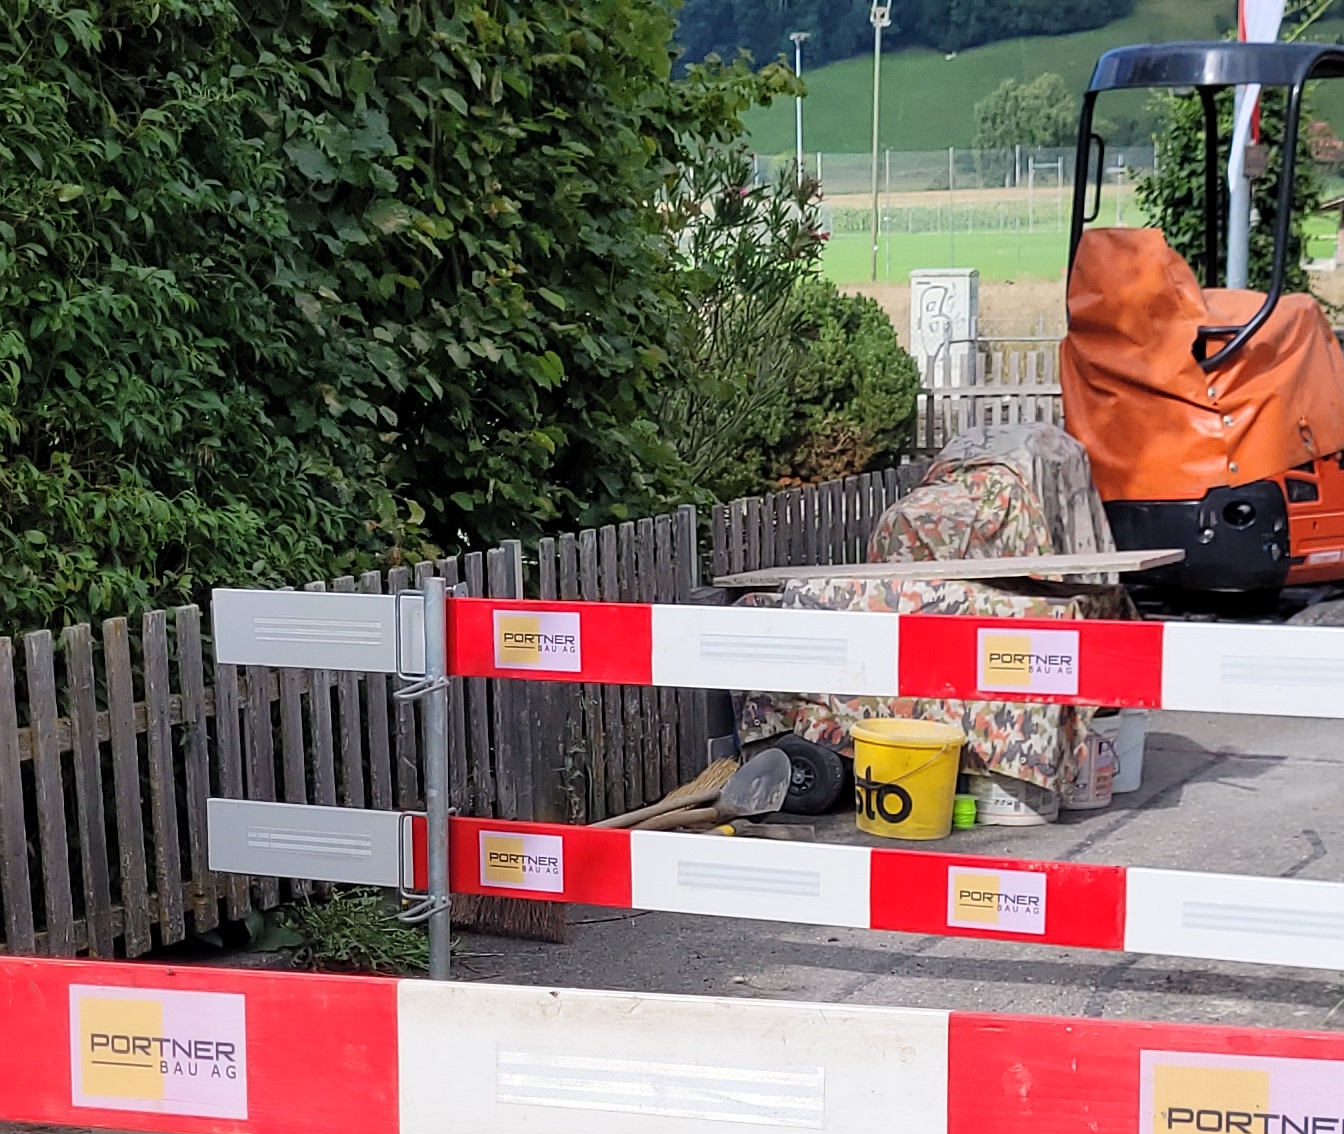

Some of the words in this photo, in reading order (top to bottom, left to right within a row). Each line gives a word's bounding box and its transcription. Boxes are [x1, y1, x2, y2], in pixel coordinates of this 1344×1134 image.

[503, 632, 575, 646] PORTNER
[562, 645, 576, 654] AG
[989, 652, 1073, 667] PORTNER
[1028, 665, 1051, 674] BAU
[1057, 666, 1073, 675] AG
[489, 851, 558, 867] PORTNER
[521, 865, 541, 874] BAU
[545, 867, 559, 875] AG
[959, 889, 1040, 907] PORTNER
[997, 904, 1019, 913] BAU
[1024, 906, 1040, 915] AG
[90, 1033, 236, 1062] PORTNER
[160, 1060, 198, 1077] BAU
[211, 1064, 237, 1079] AG
